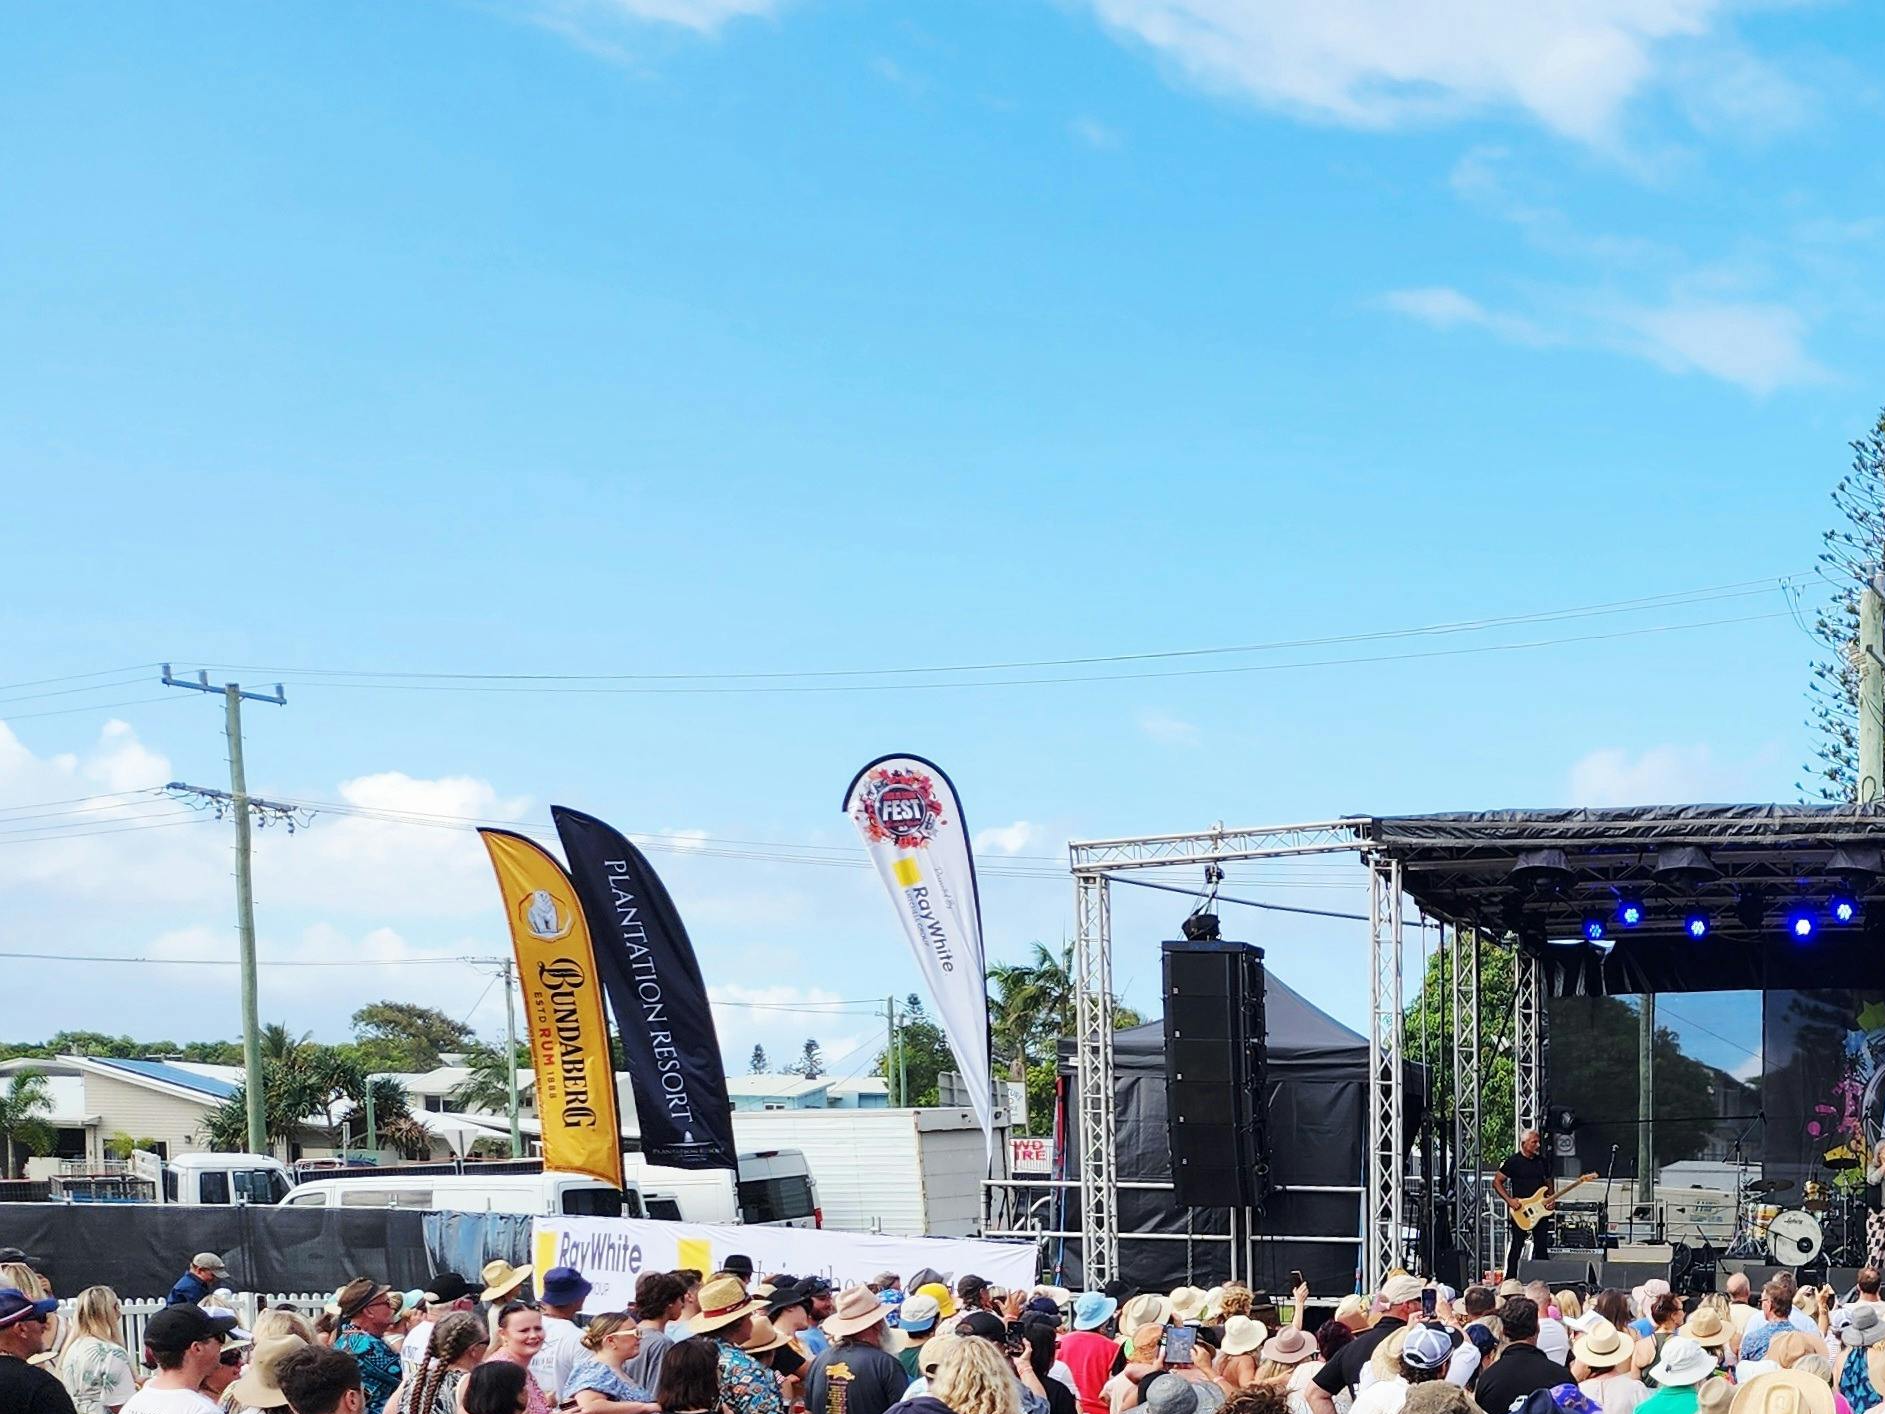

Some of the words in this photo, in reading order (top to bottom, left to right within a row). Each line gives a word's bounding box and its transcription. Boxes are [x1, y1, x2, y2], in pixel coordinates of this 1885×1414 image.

[882, 799, 922, 821] FEST
[534, 991, 546, 1023] ESTD
[604, 859, 667, 1023] PLANTATION
[650, 1028, 694, 1124] RESORT
[537, 958, 597, 1129] BUNDABERG
[539, 1027, 555, 1066] RUM
[546, 1071, 556, 1099] 1888
